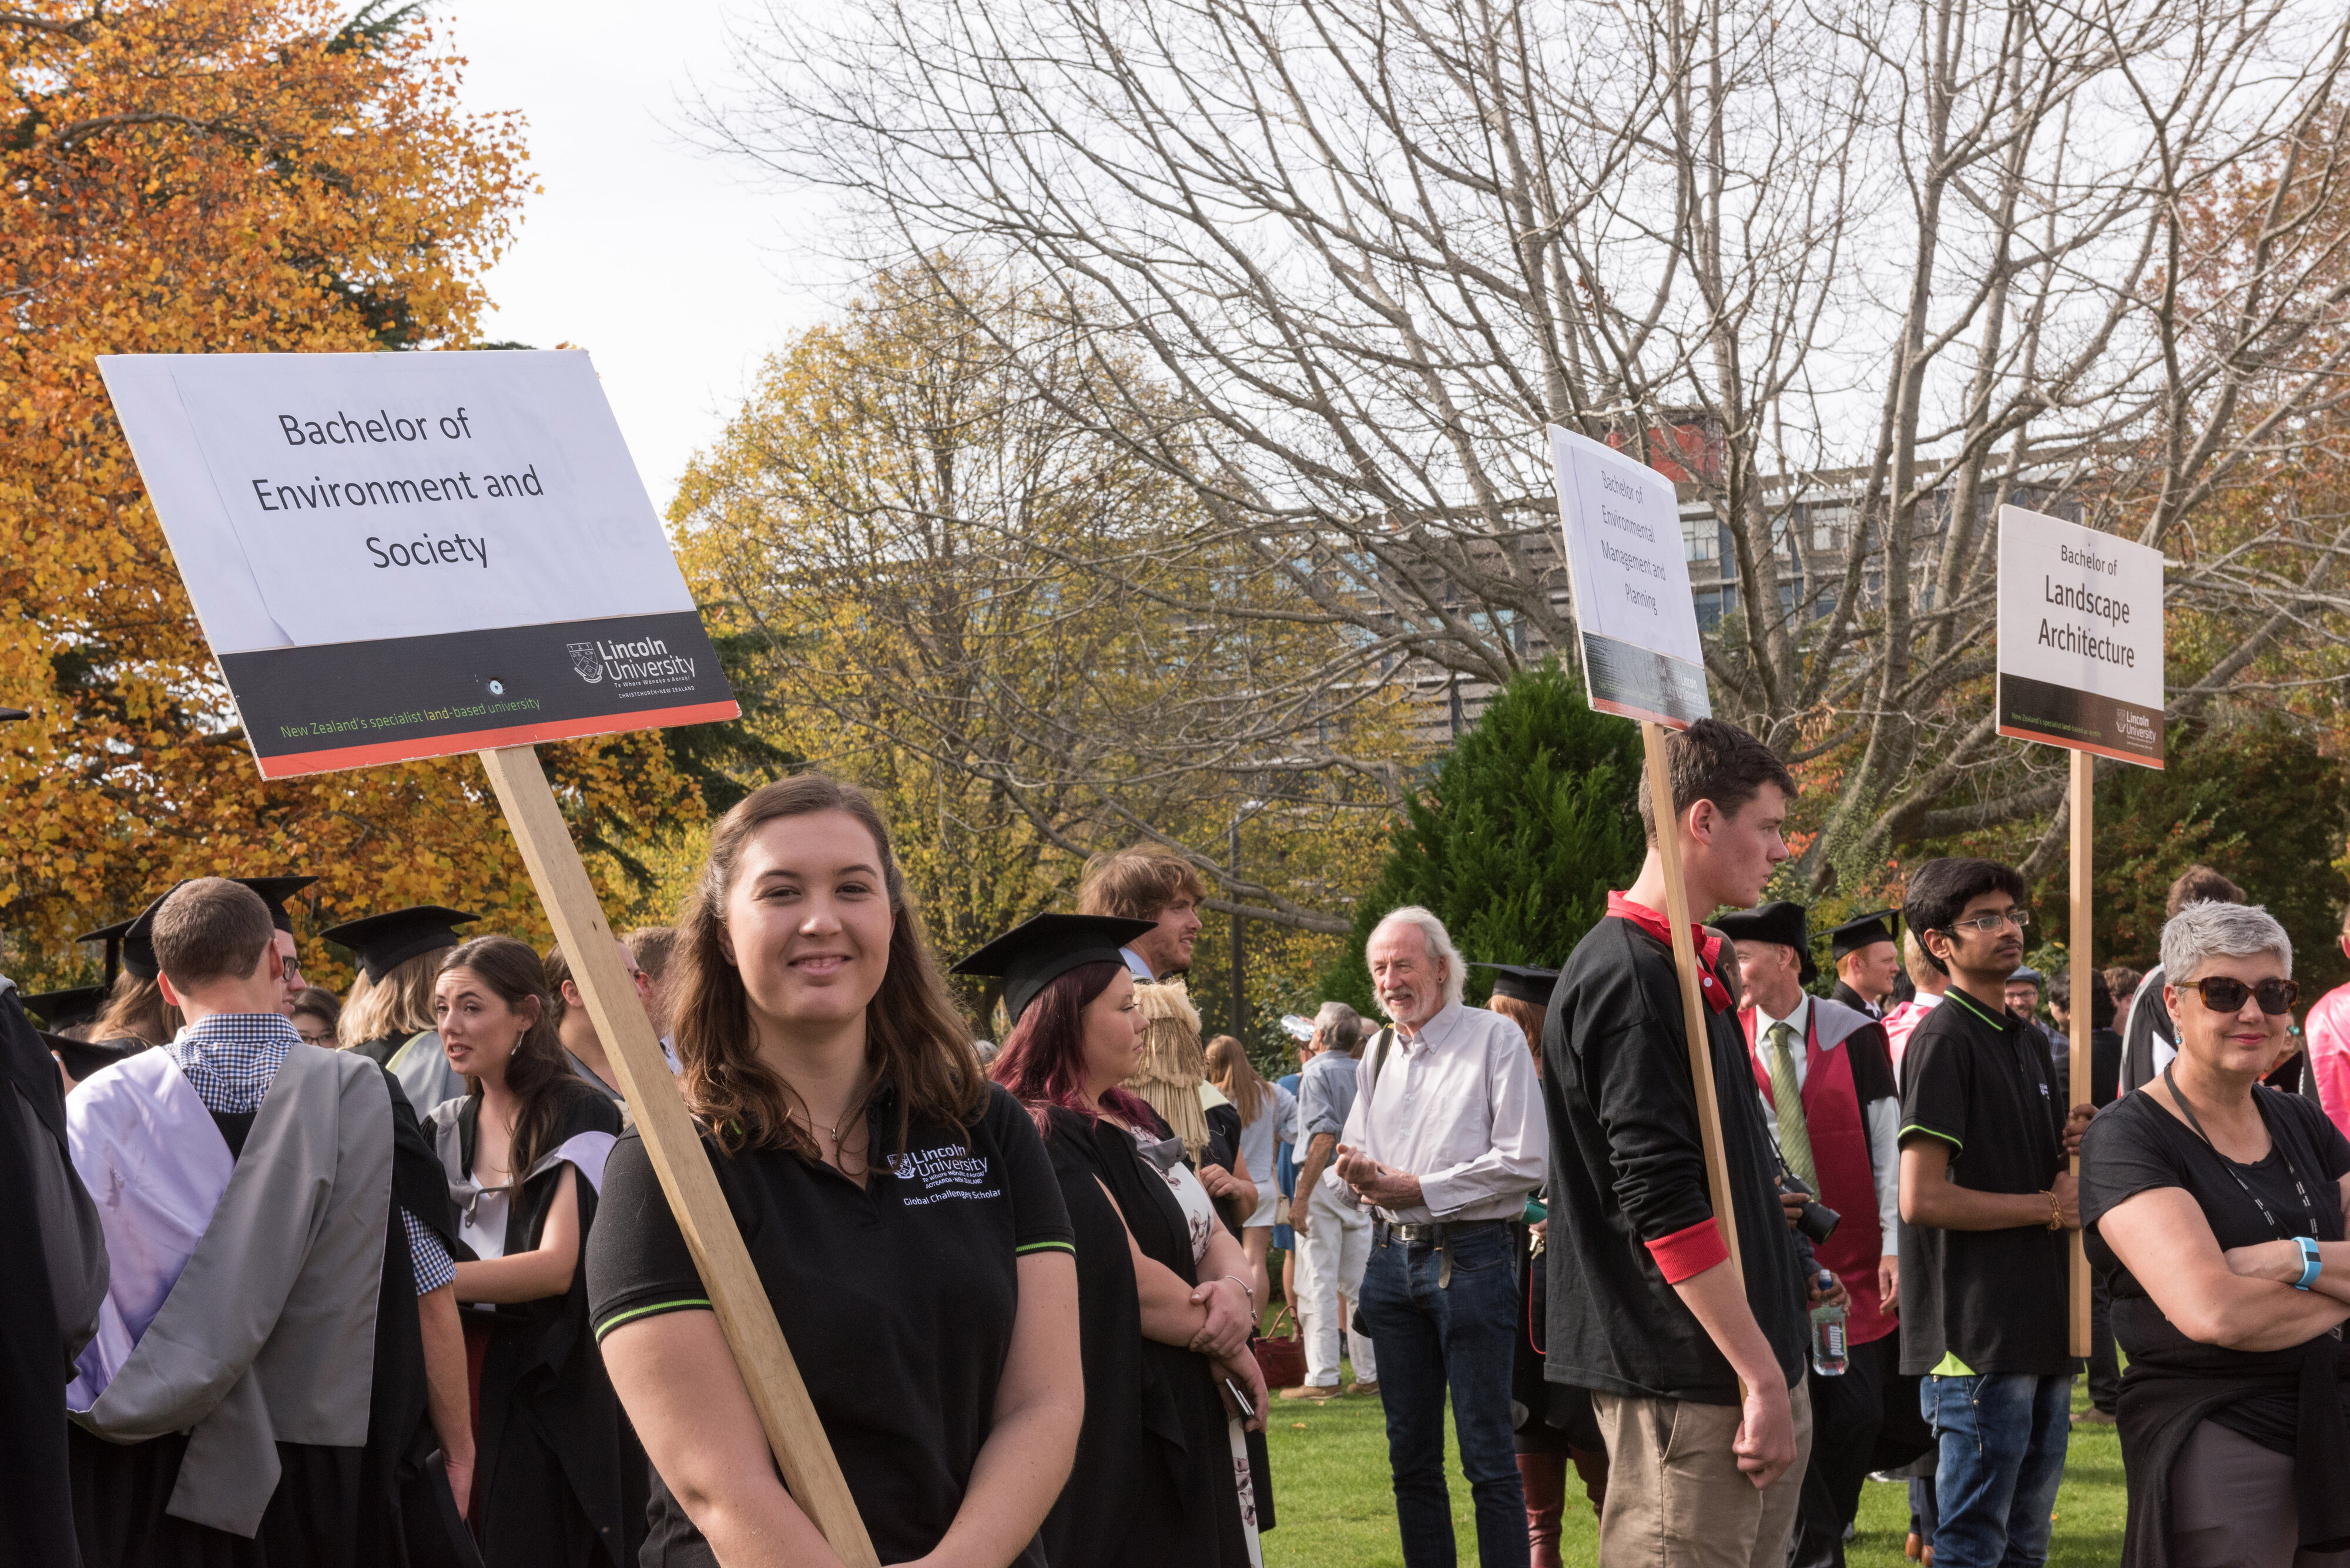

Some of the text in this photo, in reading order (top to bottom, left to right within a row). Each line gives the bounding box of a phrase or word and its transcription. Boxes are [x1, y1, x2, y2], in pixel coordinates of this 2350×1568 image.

[279, 406, 472, 446] Bachelor of
[252, 464, 544, 511] Environment and
[1601, 470, 1644, 506] Bachelor of
[1601, 505, 1656, 544] Environmental
[366, 531, 488, 569] Society
[1601, 539, 1666, 582] Management and
[2061, 544, 2118, 577] Bachelor of
[1625, 583, 1658, 616] Planning
[2046, 575, 2130, 627] Landscape
[596, 636, 668, 660] Lincoln
[2038, 617, 2135, 669] Architecture
[605, 655, 696, 680] University
[280, 697, 540, 738] New Zealand's specialist land-based university
[2126, 711, 2149, 727] Lincoln
[2126, 723, 2156, 743] University
[911, 1144, 966, 1164] Lincoln
[917, 1157, 987, 1177] University
[929, 1172, 947, 1181] Whare
[903, 1188, 1001, 1206] Global Challenges Scholar
[1829, 1325, 1844, 1356] pump
